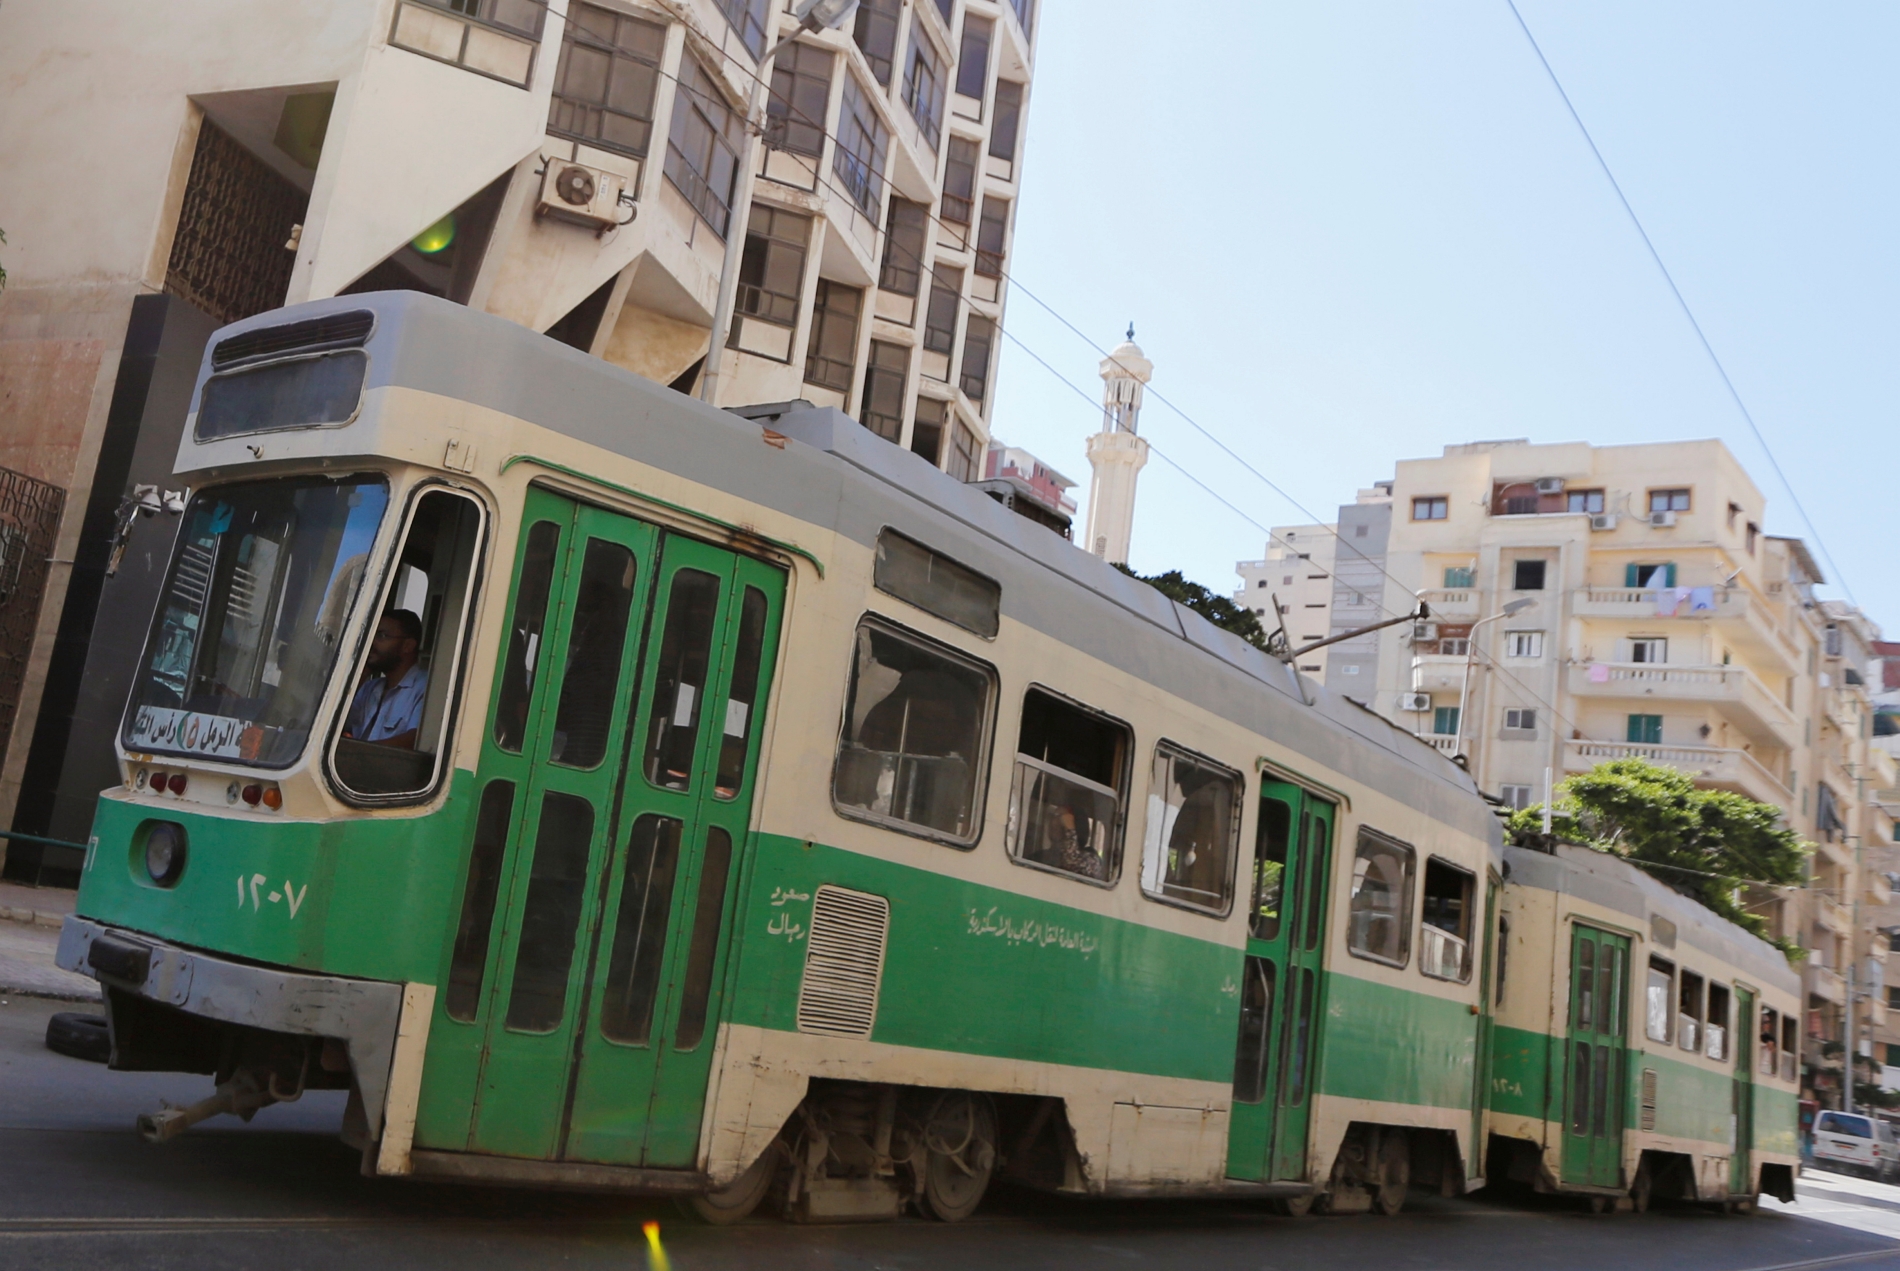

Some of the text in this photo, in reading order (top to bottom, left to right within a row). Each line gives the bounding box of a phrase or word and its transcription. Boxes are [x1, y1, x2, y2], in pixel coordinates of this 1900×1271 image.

[151, 711, 176, 744] رأس
[200, 717, 236, 753] الرمل
[237, 873, 307, 920] ١٢٠٧
[771, 886, 810, 906] صعود
[767, 913, 806, 943] رجال
[1493, 1078, 1523, 1097] ١٢٠٨
